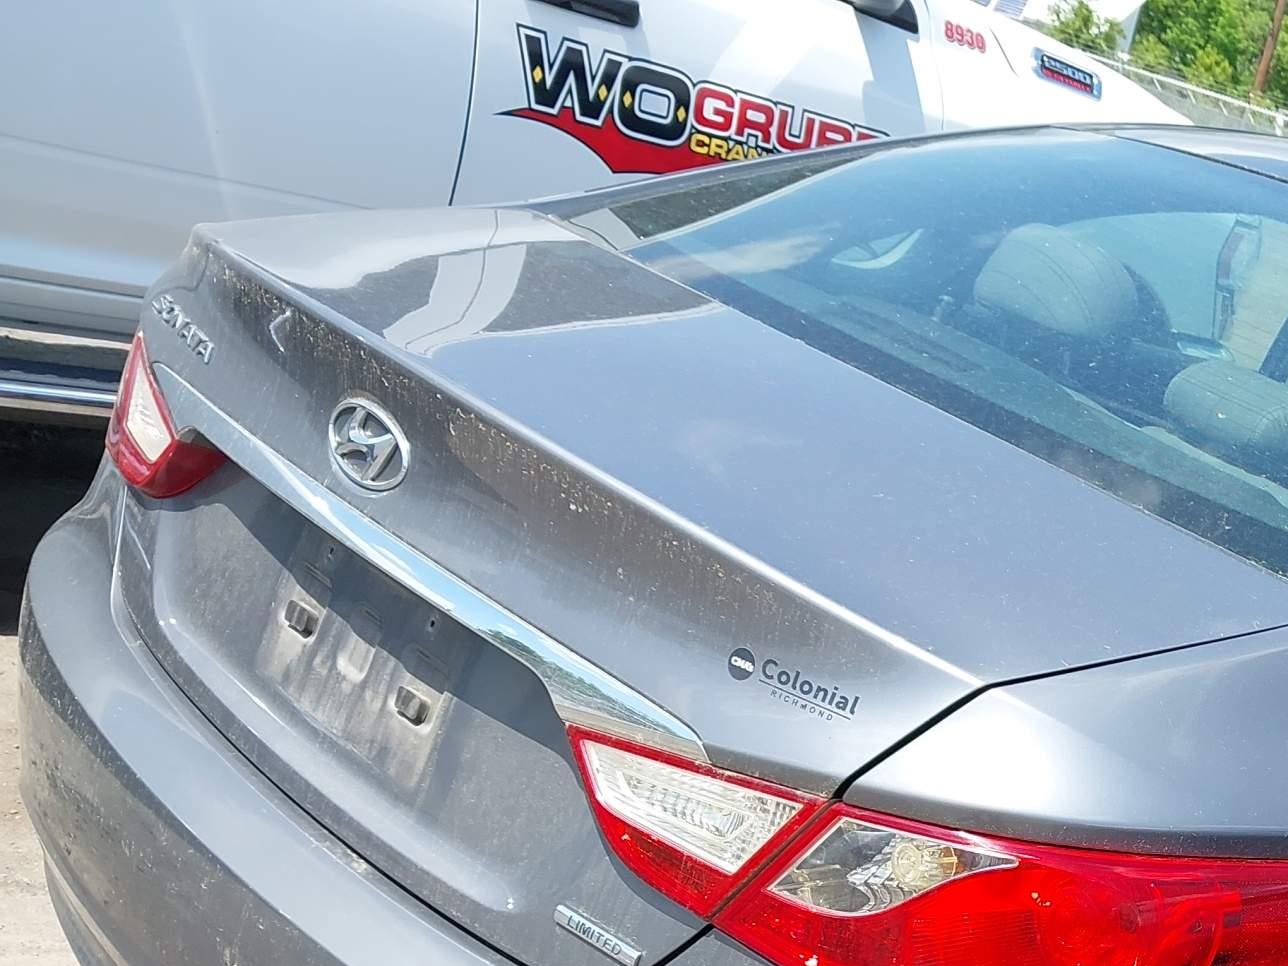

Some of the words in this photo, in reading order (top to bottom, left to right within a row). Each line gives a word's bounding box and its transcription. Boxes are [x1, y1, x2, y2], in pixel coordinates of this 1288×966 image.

[944, 20, 987, 54] 8930
[151, 294, 216, 364] SONATA
[761, 658, 861, 716] Colonial
[769, 689, 834, 722] RICHMOND
[566, 915, 622, 956] LIMITED
